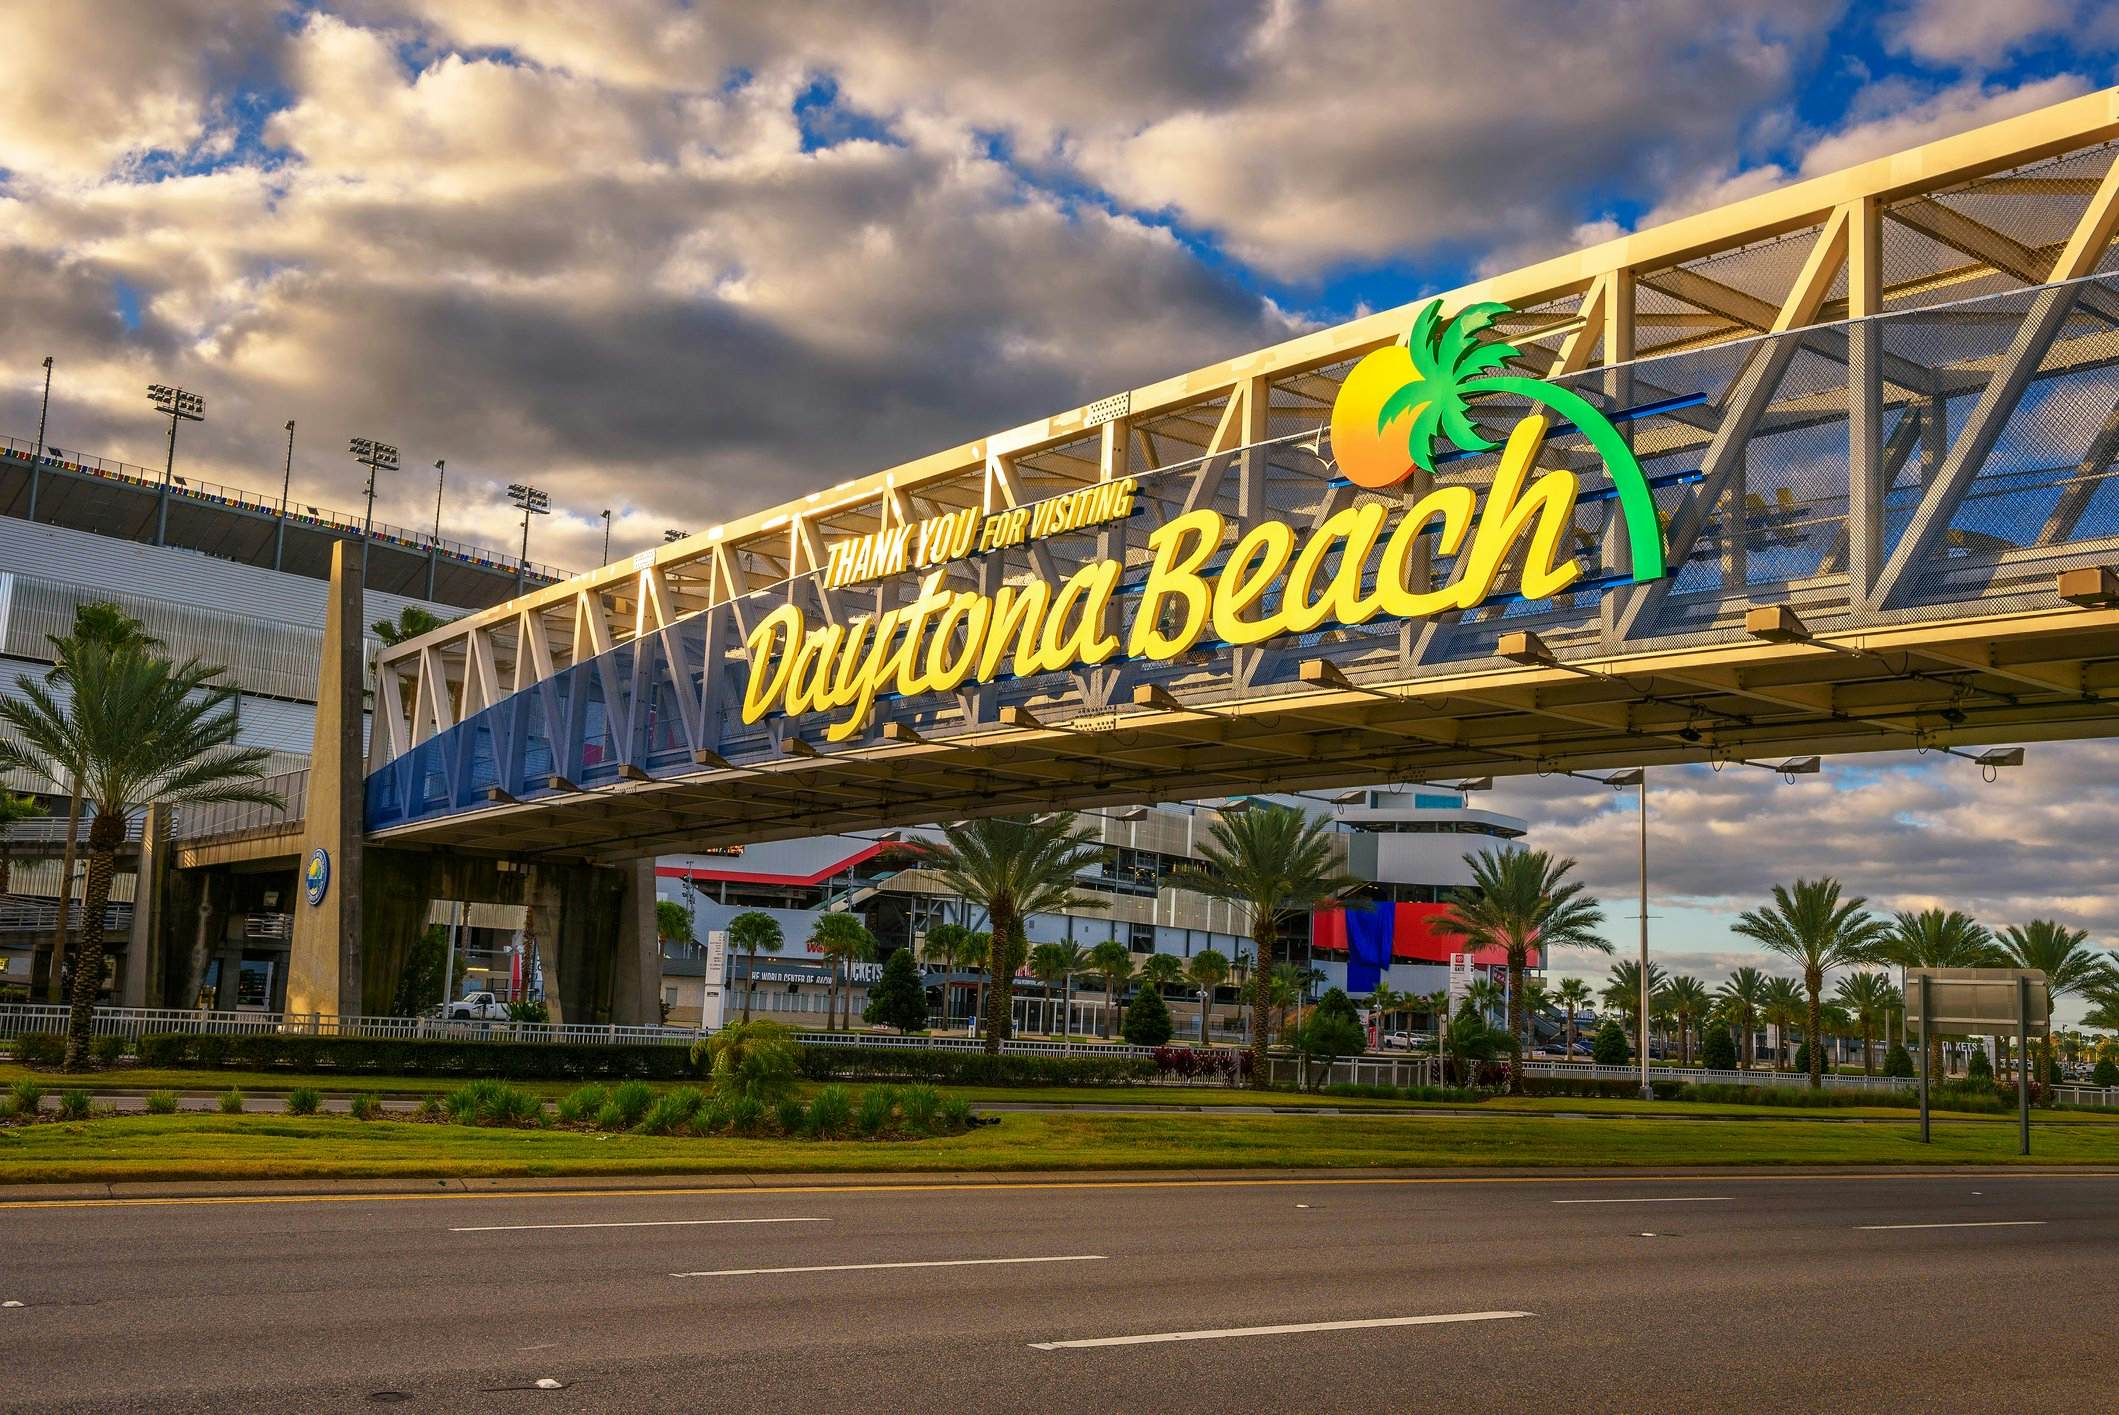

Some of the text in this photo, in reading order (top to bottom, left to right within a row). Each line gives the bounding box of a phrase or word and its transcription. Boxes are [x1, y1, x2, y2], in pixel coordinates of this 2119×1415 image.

[742, 415, 1584, 742] Daytona Beach
[824, 478, 1137, 589] THANK YOU FOR VISITING
